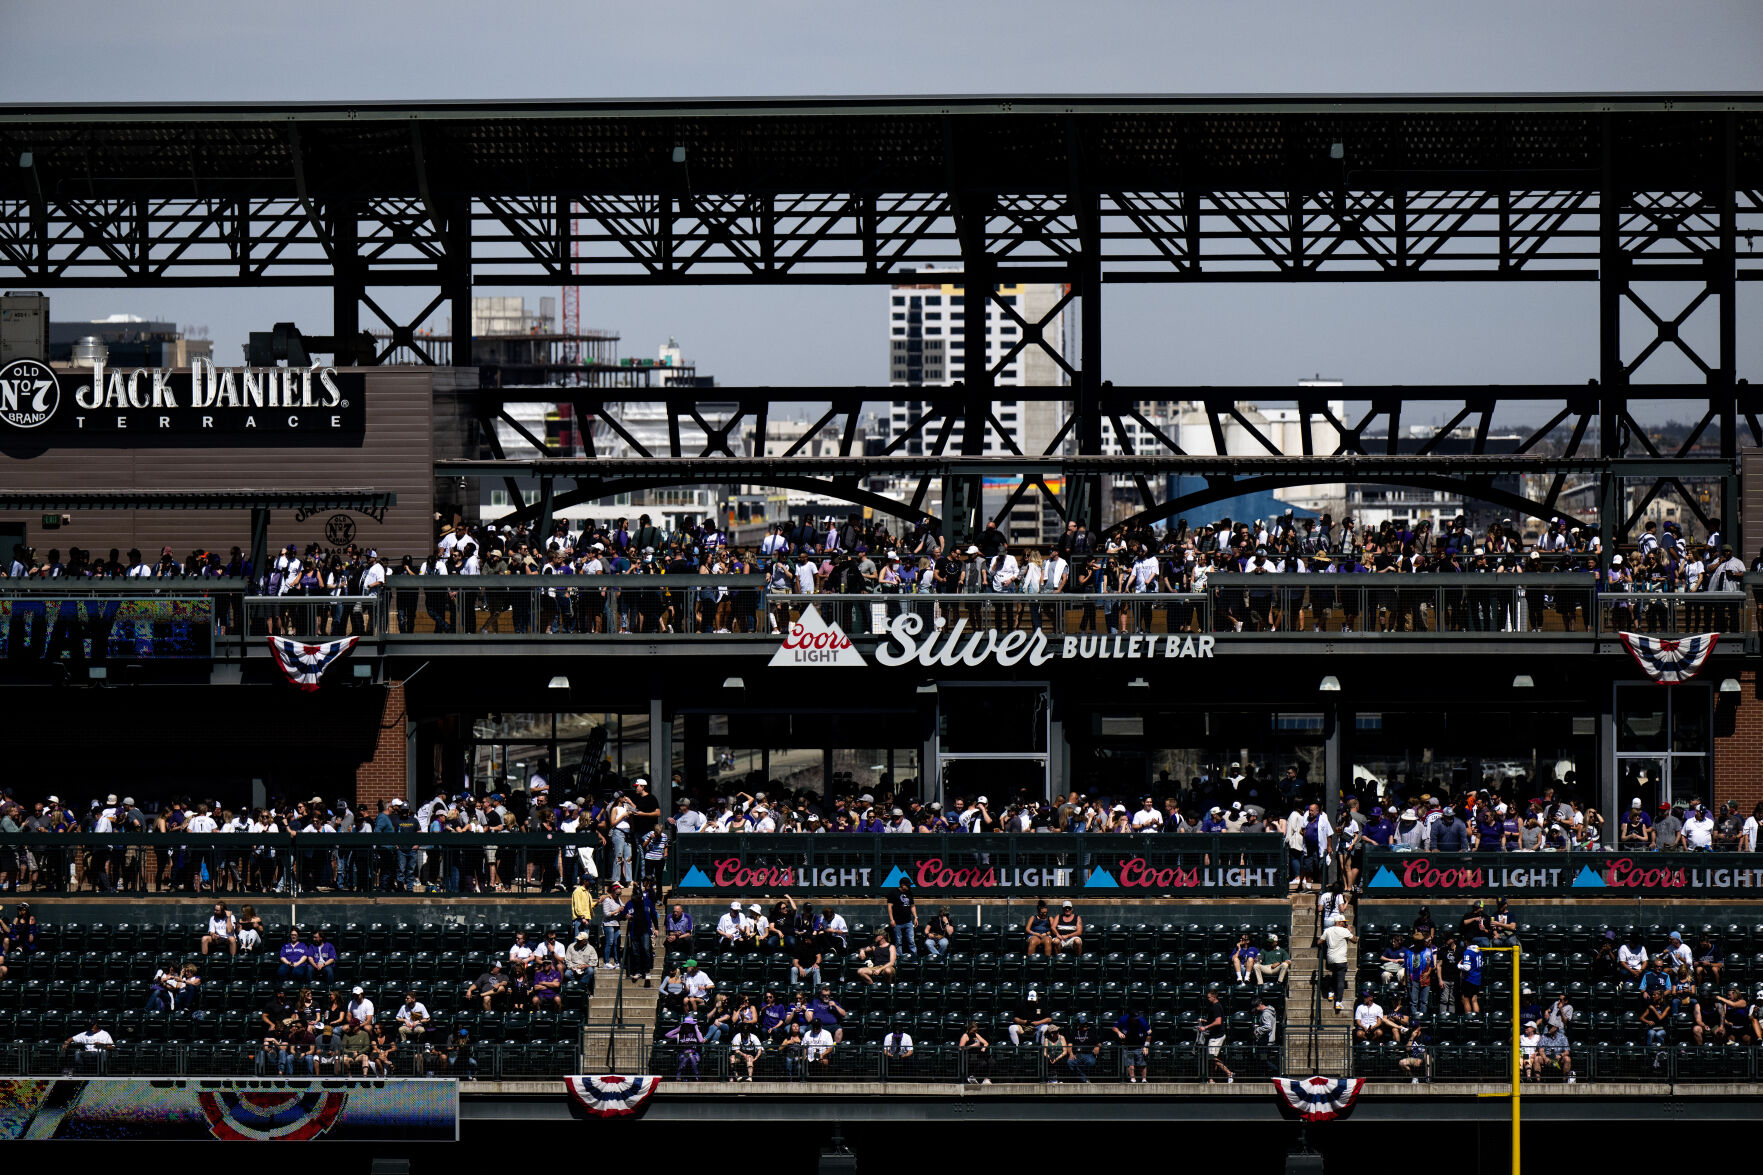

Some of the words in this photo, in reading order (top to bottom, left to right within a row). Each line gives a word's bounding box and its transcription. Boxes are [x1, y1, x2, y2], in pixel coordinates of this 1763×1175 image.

[13, 365, 39, 377] OLD
[8, 412, 46, 424] BRAND
[76, 416, 341, 429] TERRACE
[782, 624, 852, 650] Coors
[875, 612, 1054, 667] Silver
[1062, 635, 1159, 659] BULLET
[1165, 635, 1215, 659] BAR
[794, 650, 839, 663] LIGHT
[714, 857, 796, 887] Coors
[798, 867, 872, 887] LIGHT
[916, 858, 998, 888] Coors
[1000, 867, 1074, 887] LIGHT
[1119, 857, 1200, 888] Coors
[1203, 867, 1277, 887] LIGHT
[1403, 858, 1484, 888] Coors
[1488, 868, 1562, 887] LIGHT
[1606, 858, 1688, 888] Coors
[1691, 868, 1763, 888] LIGHT
